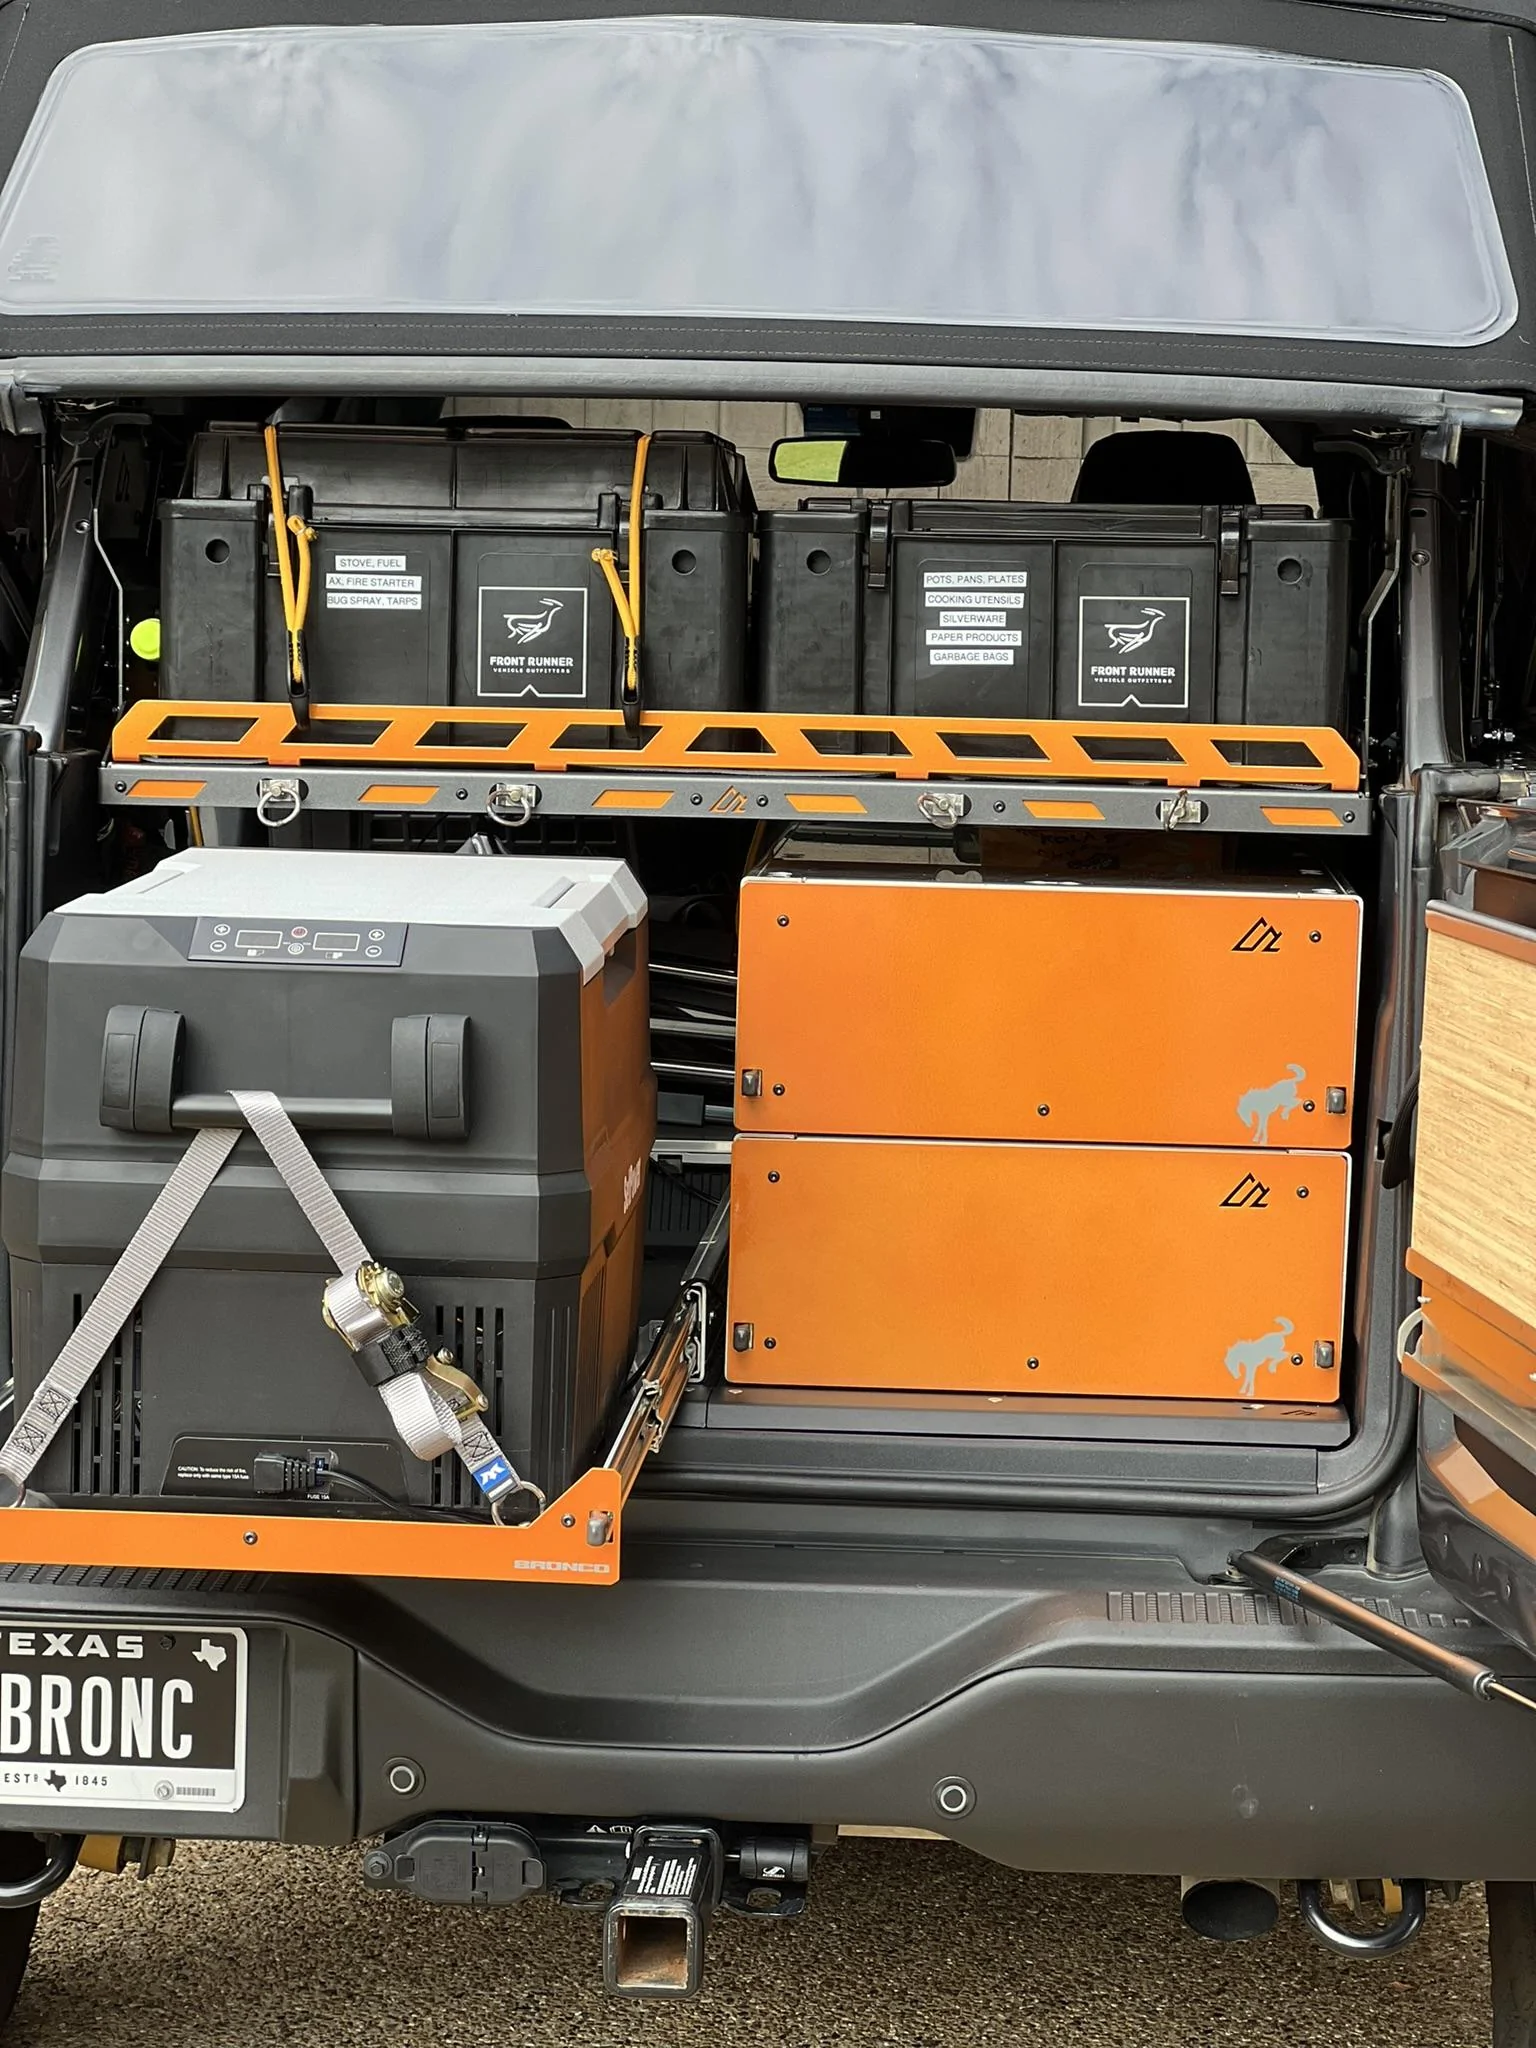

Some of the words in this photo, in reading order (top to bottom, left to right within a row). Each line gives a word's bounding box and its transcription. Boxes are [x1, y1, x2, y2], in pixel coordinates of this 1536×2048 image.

[339, 558, 375, 568] STOVE,
[377, 558, 402, 568] FUEL
[328, 576, 344, 586] AX,
[346, 577, 368, 586] FIRE
[370, 578, 415, 588] STARTER
[926, 575, 955, 584] POTS,
[957, 575, 986, 584] PANS,
[988, 574, 1025, 584] PLATES
[327, 595, 348, 605] BUG
[350, 596, 385, 606] SPRAY,
[386, 596, 418, 606] TARPS
[927, 594, 973, 604] COOKING
[974, 595, 1021, 605] UTENSILS
[943, 614, 1005, 623] SILVERWARE
[931, 632, 963, 641] PAPER
[965, 633, 1019, 642] PRODUCTS
[489, 656, 525, 666] FRONT
[527, 656, 574, 667] RUNNER
[933, 652, 980, 662] GARBAGE
[982, 652, 1009, 661] BAGS
[1090, 666, 1127, 676] FRONT
[1129, 666, 1176, 677] RUNNER
[513, 1559, 611, 1574] BRONCO
[0, 1631, 144, 1659] EXAS
[0, 1673, 194, 1760] BRONC
[75, 1775, 108, 1786] 1845
